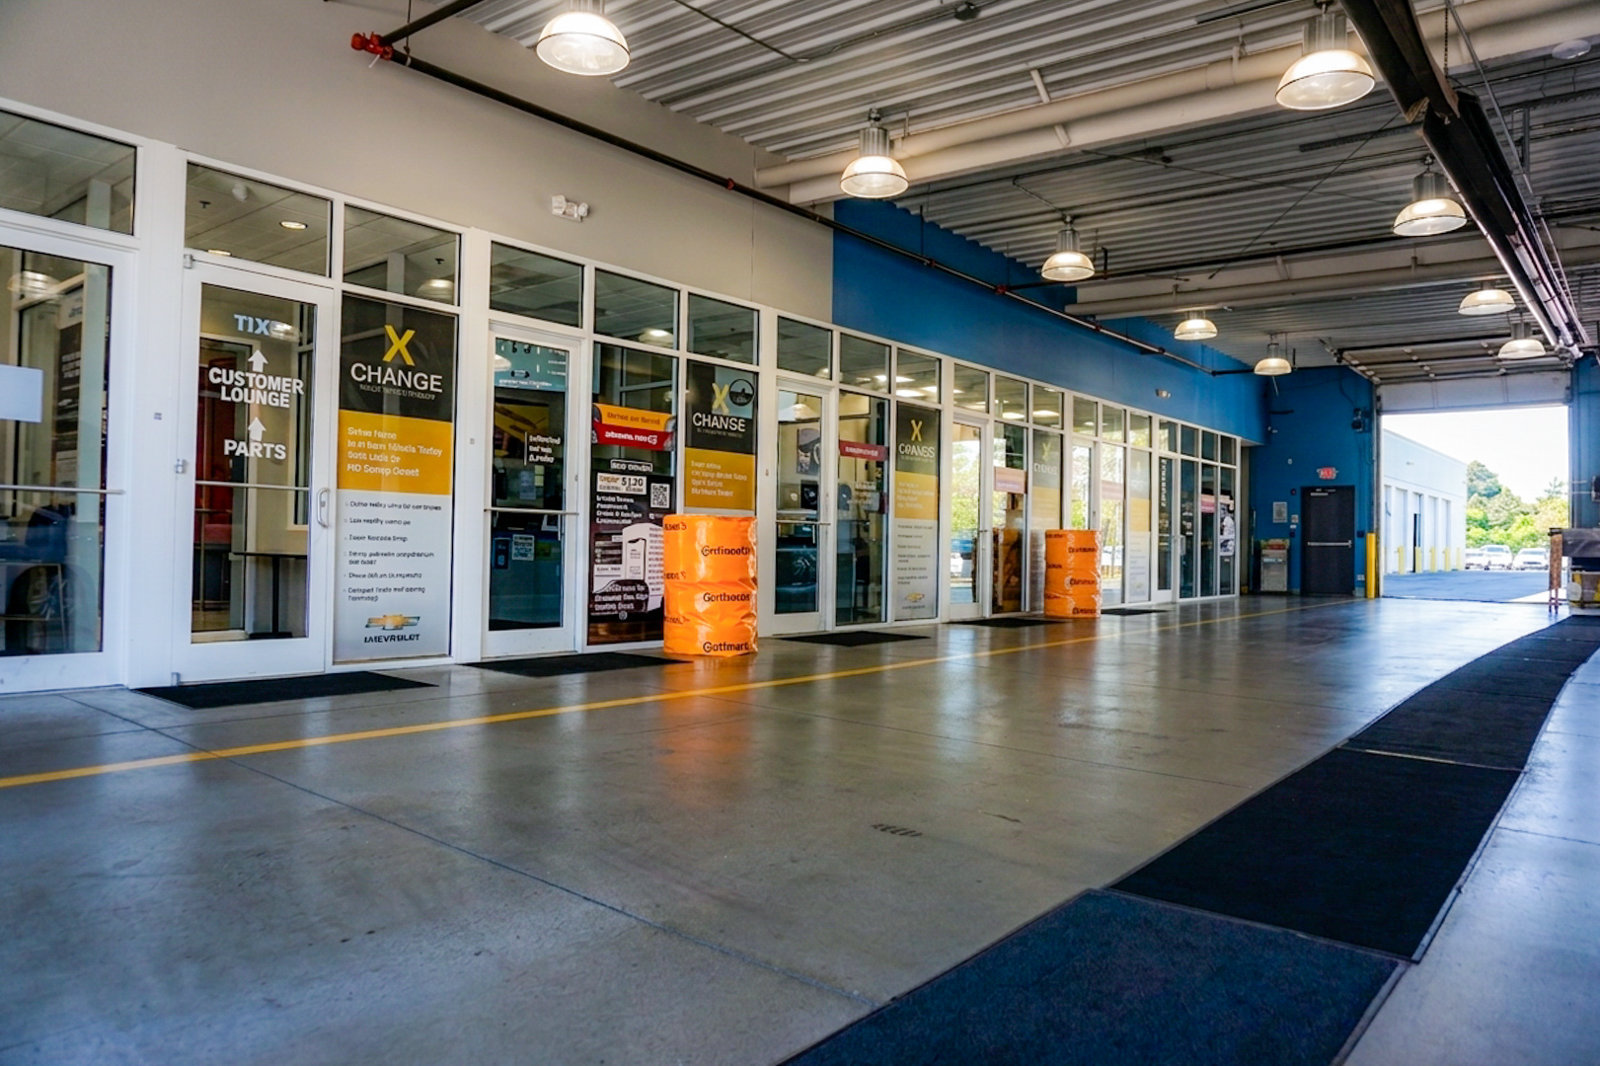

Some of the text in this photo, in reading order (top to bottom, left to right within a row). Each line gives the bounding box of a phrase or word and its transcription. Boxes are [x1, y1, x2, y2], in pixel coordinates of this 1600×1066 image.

[382, 325, 415, 367] X
[208, 367, 304, 395] CUSTOMER
[350, 362, 443, 393] CHANGE
[220, 386, 290, 408] LOUNGE
[223, 439, 287, 460] PARTS
